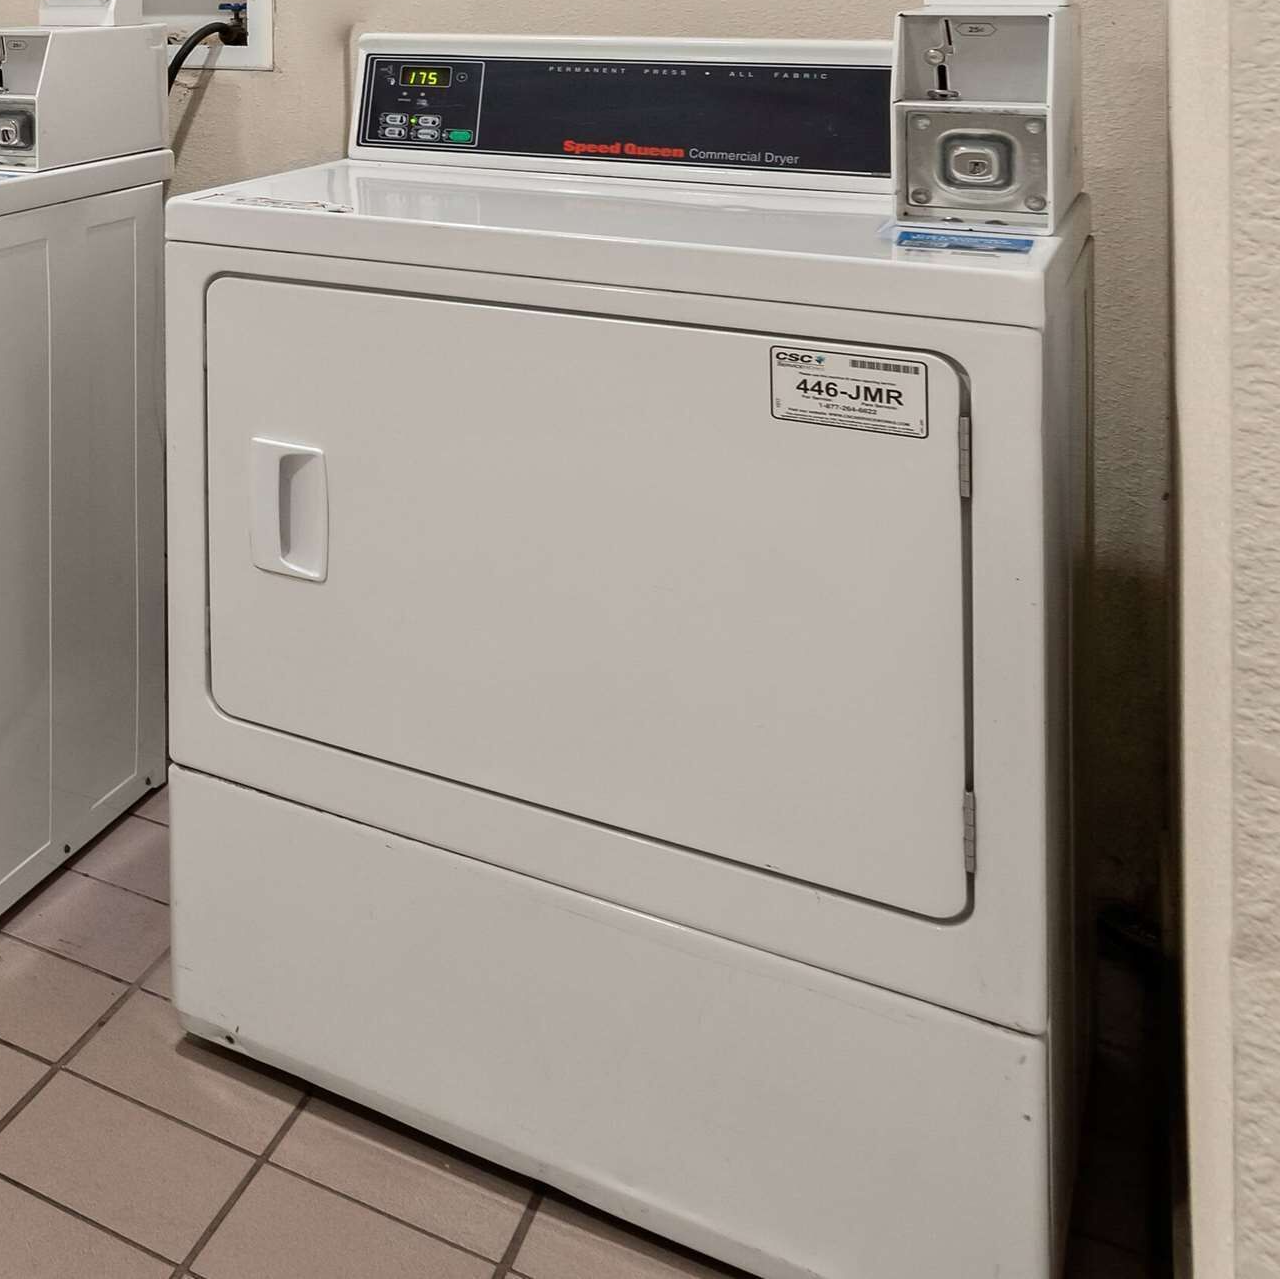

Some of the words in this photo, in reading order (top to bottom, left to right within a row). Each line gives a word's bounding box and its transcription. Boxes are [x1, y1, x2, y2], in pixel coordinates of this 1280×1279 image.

[409, 71, 438, 85] 175
[549, 66, 626, 74] PERMANENT
[644, 68, 687, 76] PRESS
[773, 71, 828, 80] FABRIC
[563, 139, 622, 156] Speed
[623, 142, 685, 158] Queen
[688, 148, 761, 162] Commercial
[764, 152, 800, 166] Dryer
[775, 351, 813, 364] CSC
[795, 378, 904, 407] 446-JMR
